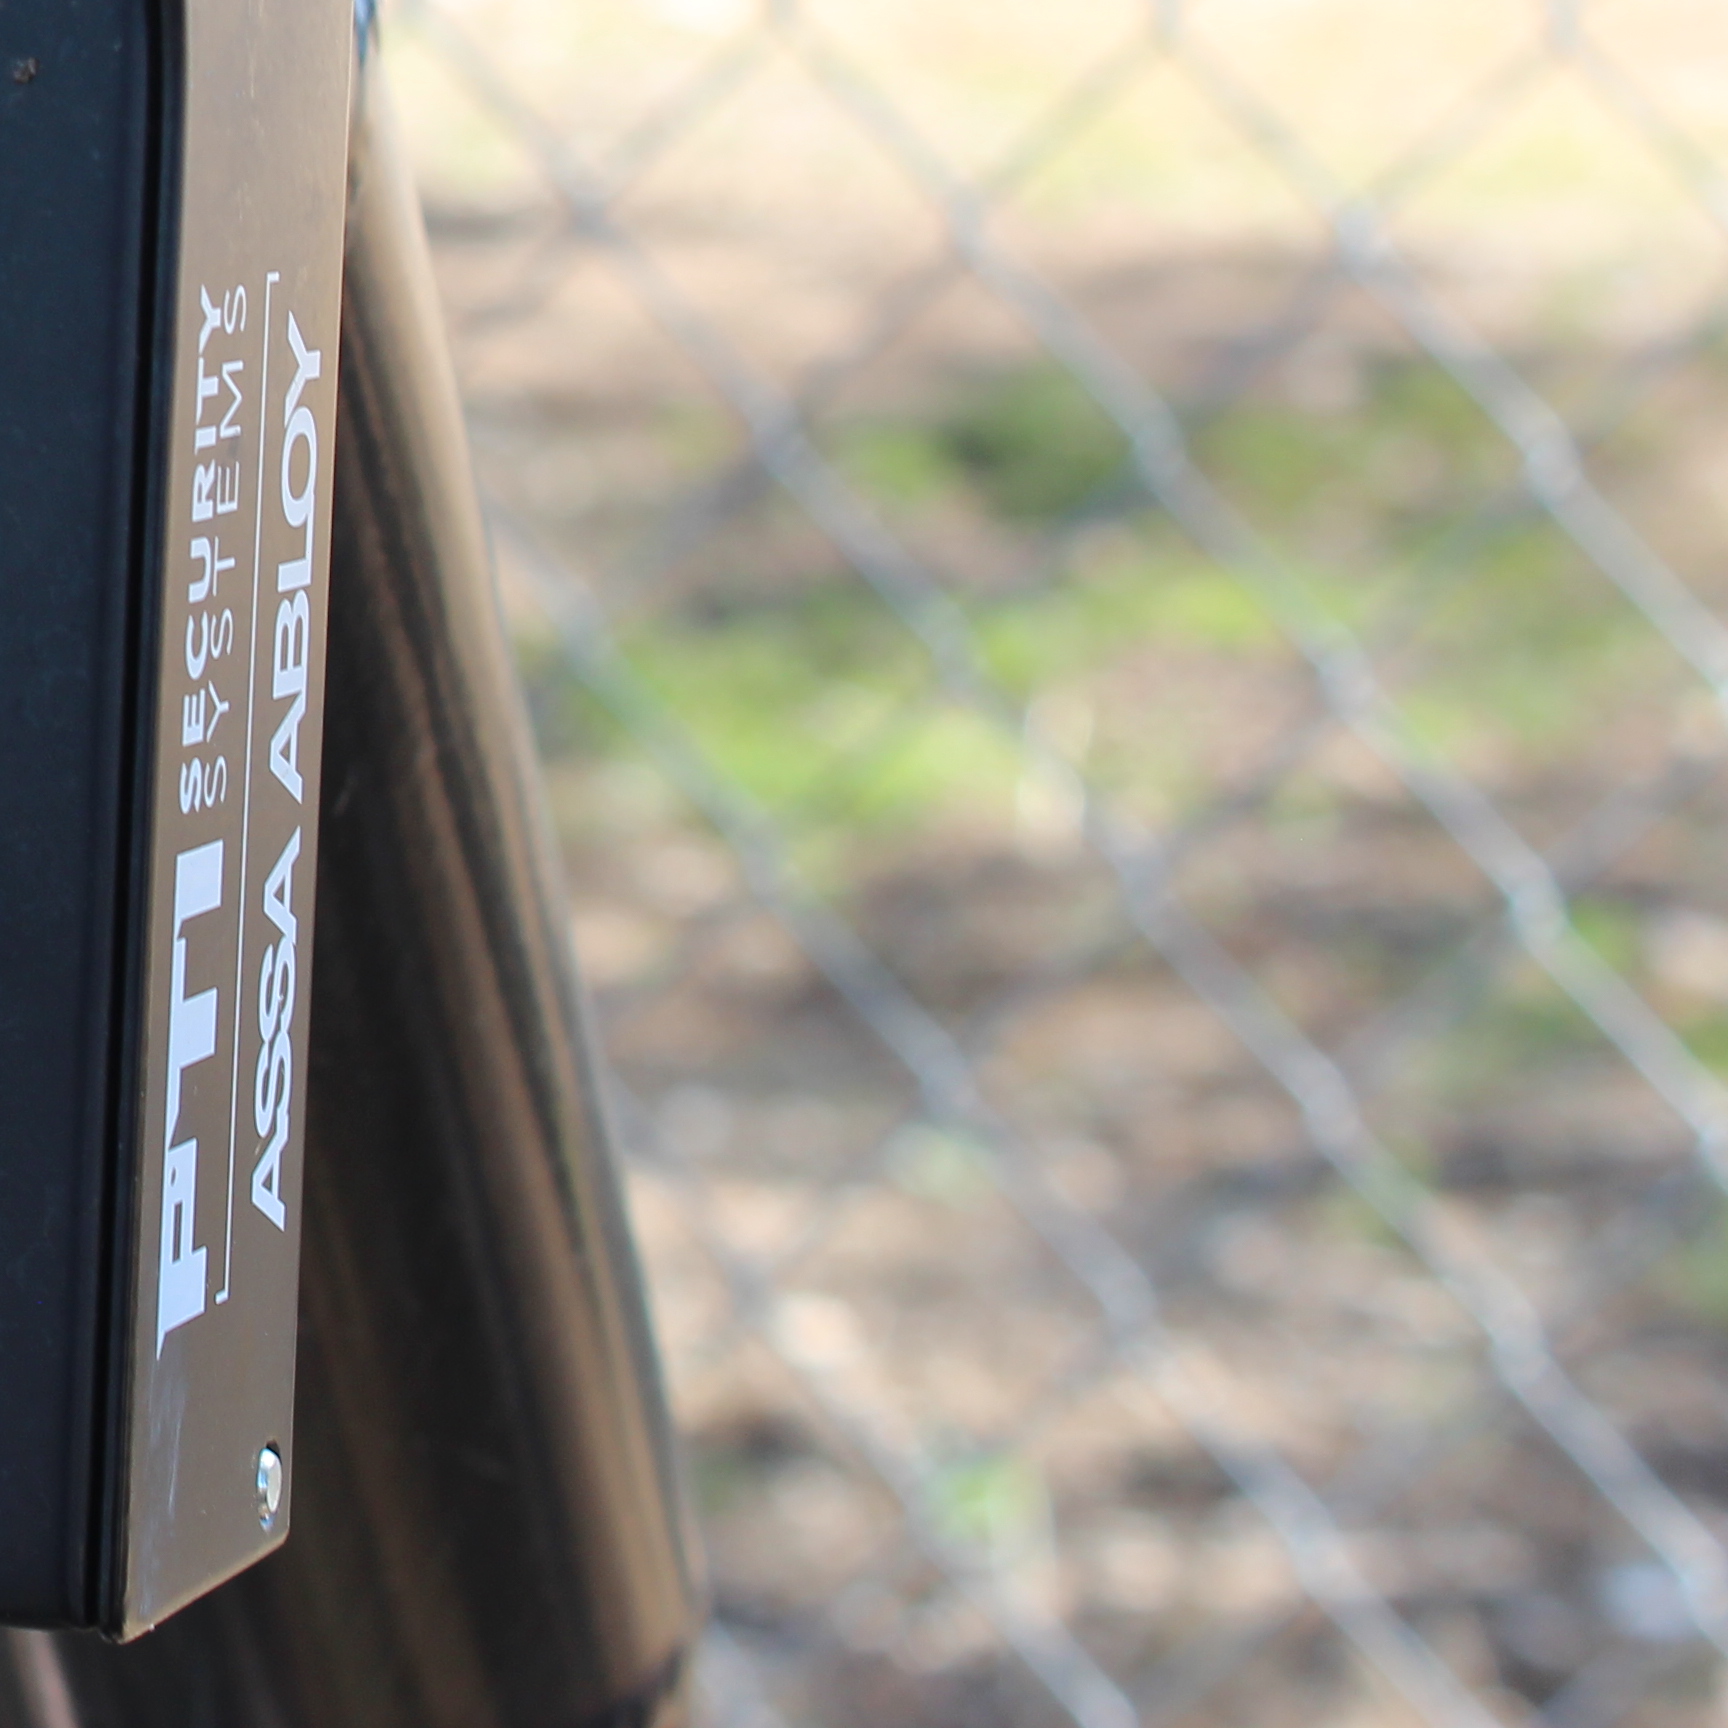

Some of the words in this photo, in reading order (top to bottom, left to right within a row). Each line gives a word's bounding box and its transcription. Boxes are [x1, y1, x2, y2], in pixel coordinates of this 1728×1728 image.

[178, 283, 222, 815] SECURITY
[204, 283, 248, 808] SYSTEMS
[268, 309, 322, 805] ABLOY
[155, 838, 225, 1361] PTI
[249, 824, 302, 1232] ASSA
